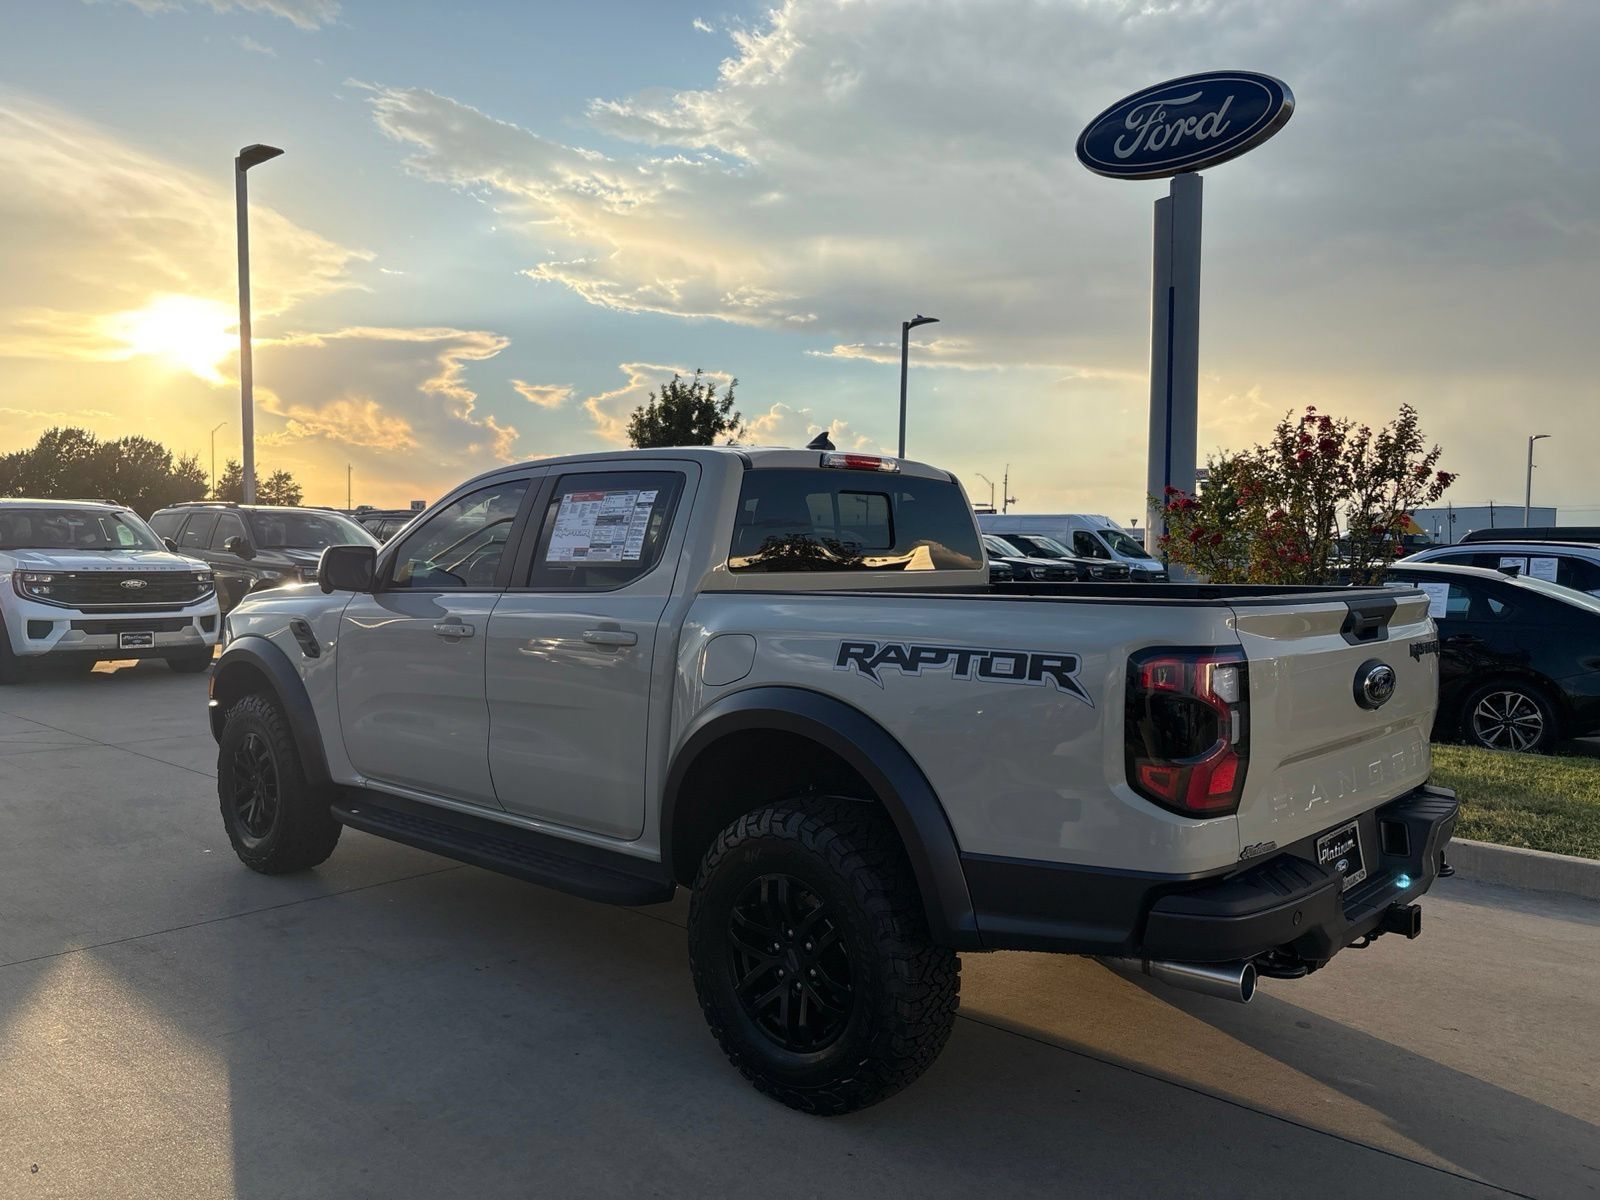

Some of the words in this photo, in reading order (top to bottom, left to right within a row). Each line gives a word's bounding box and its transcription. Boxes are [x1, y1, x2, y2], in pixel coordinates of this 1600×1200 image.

[1114, 91, 1235, 159] Ford
[833, 639, 1095, 709] RAPTOR
[1320, 838, 1356, 865] Platinum
